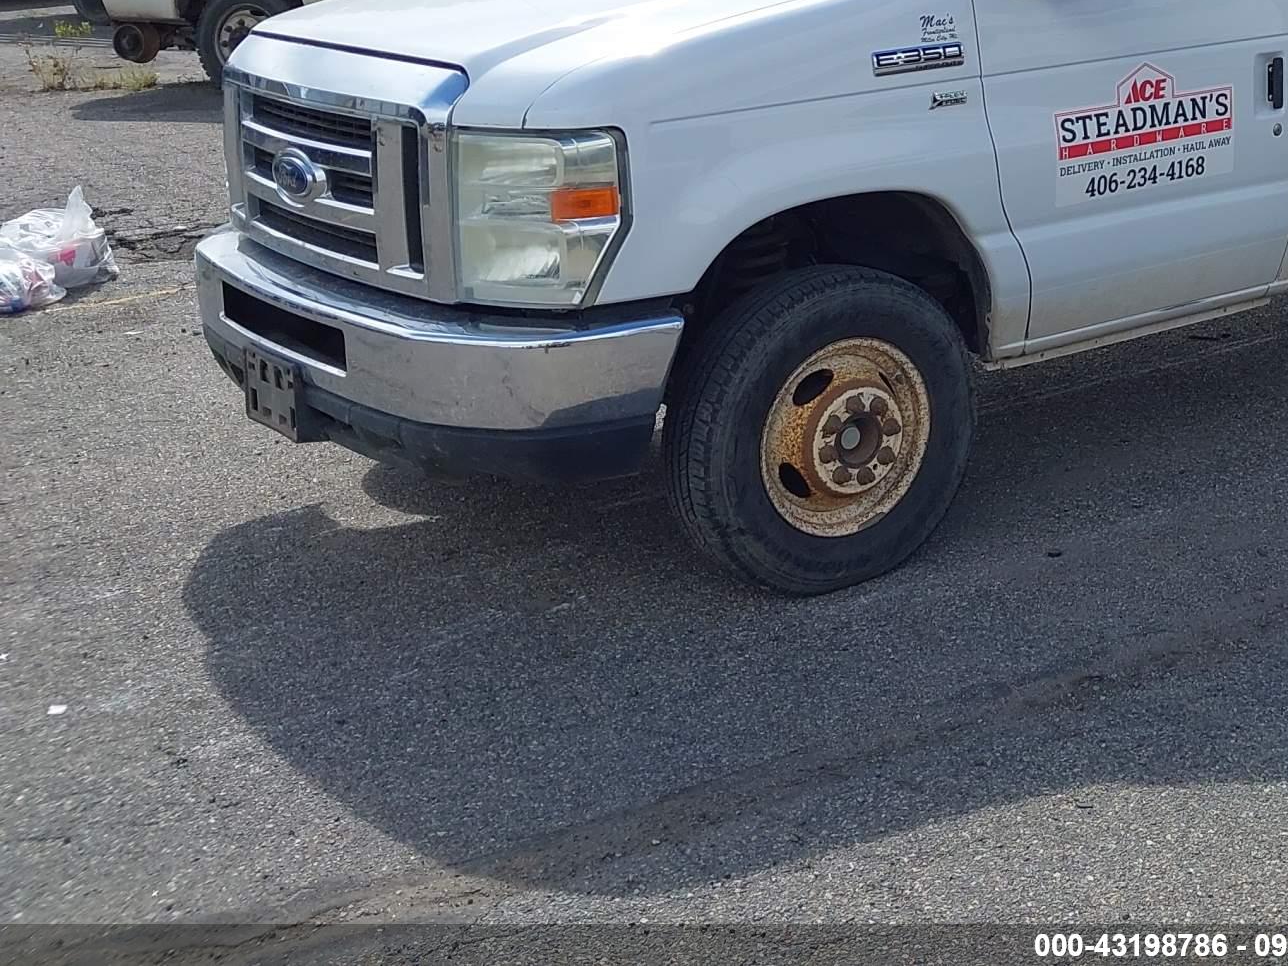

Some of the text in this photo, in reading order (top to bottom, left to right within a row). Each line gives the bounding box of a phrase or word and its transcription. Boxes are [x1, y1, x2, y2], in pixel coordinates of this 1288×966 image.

[920, 13, 954, 27] Mac's
[1124, 78, 1167, 104] ACE
[1060, 92, 1229, 143] STEADMAN'S
[1060, 136, 1232, 177] DELIVERY INSTALLATION HAUL AWAY
[1062, 120, 1229, 159] HARDWARE
[1085, 156, 1205, 197] 406-234-4168
